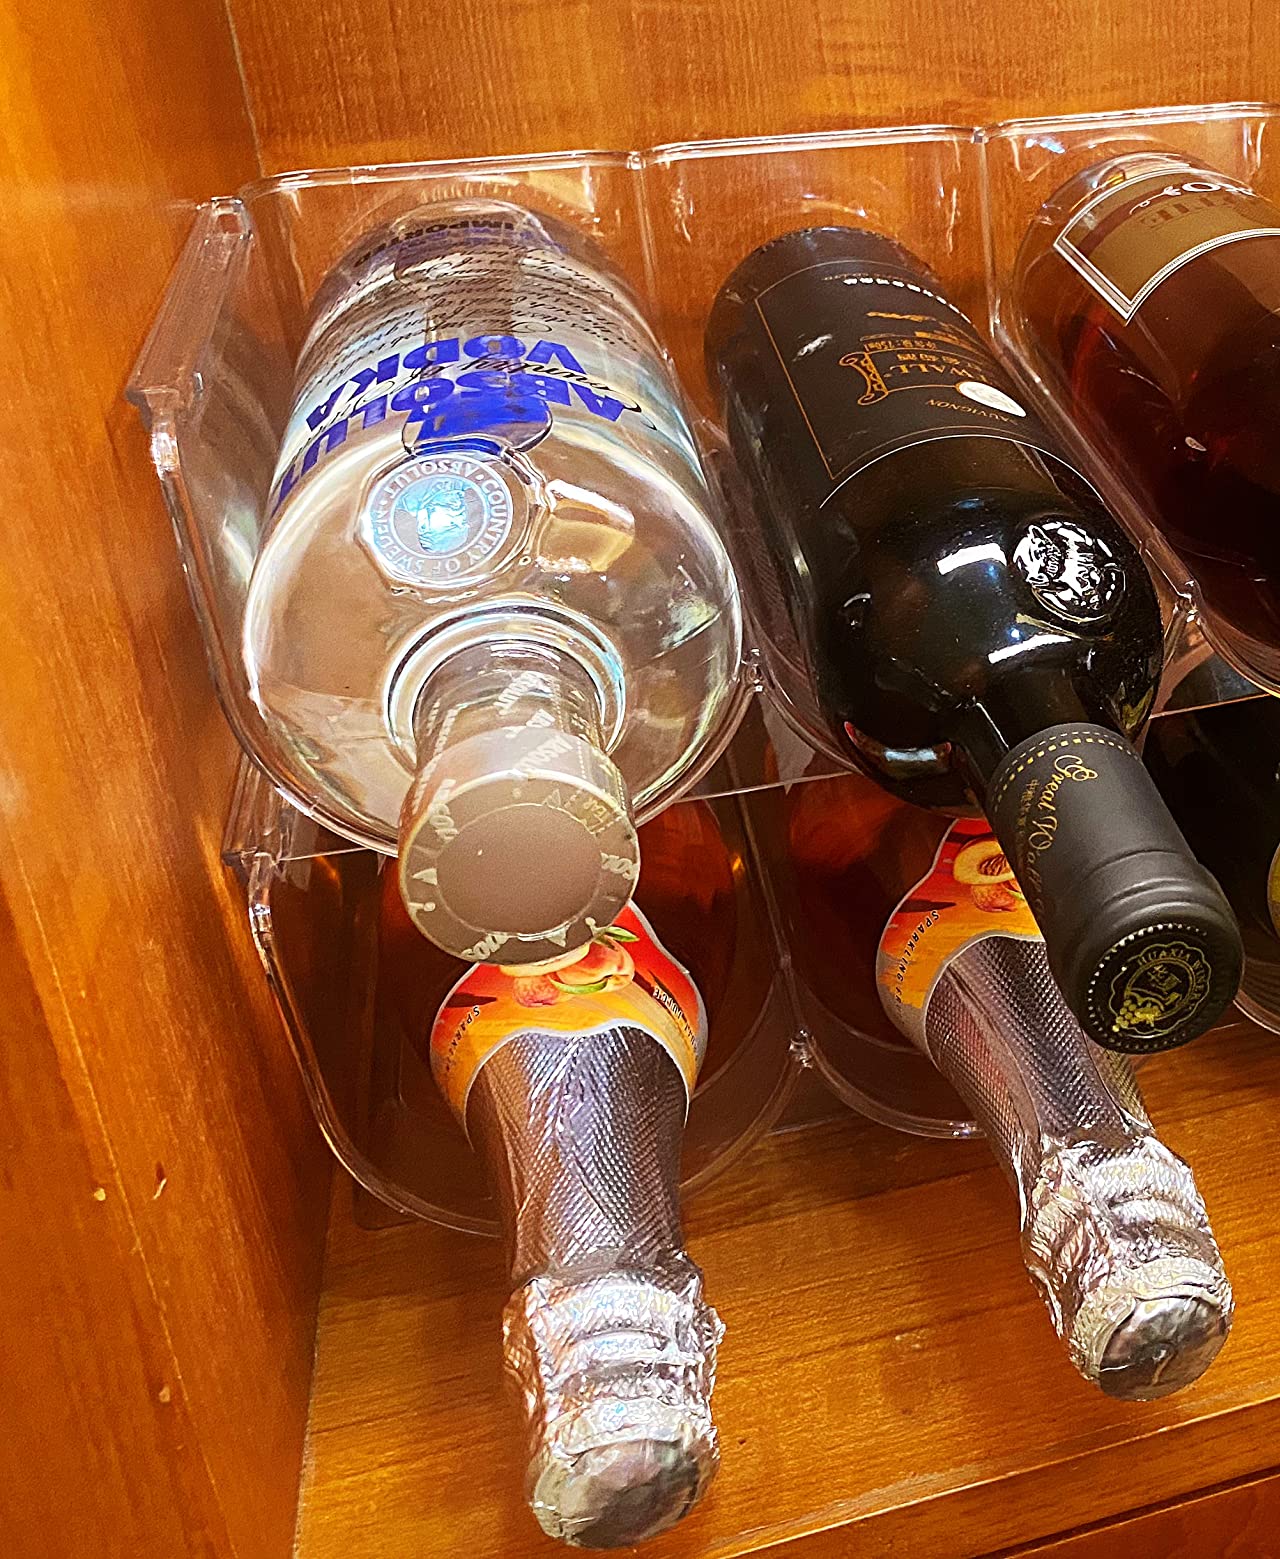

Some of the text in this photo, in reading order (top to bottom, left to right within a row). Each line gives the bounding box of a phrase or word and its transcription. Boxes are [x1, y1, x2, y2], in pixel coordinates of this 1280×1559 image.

[305, 336, 586, 431] VODKA
[267, 372, 624, 518] ABSOLUT
[384, 461, 480, 499] ABSOLUT
[466, 480, 508, 566] COUNTRY
[432, 559, 461, 576] OF
[895, 910, 941, 983] SPARKLING
